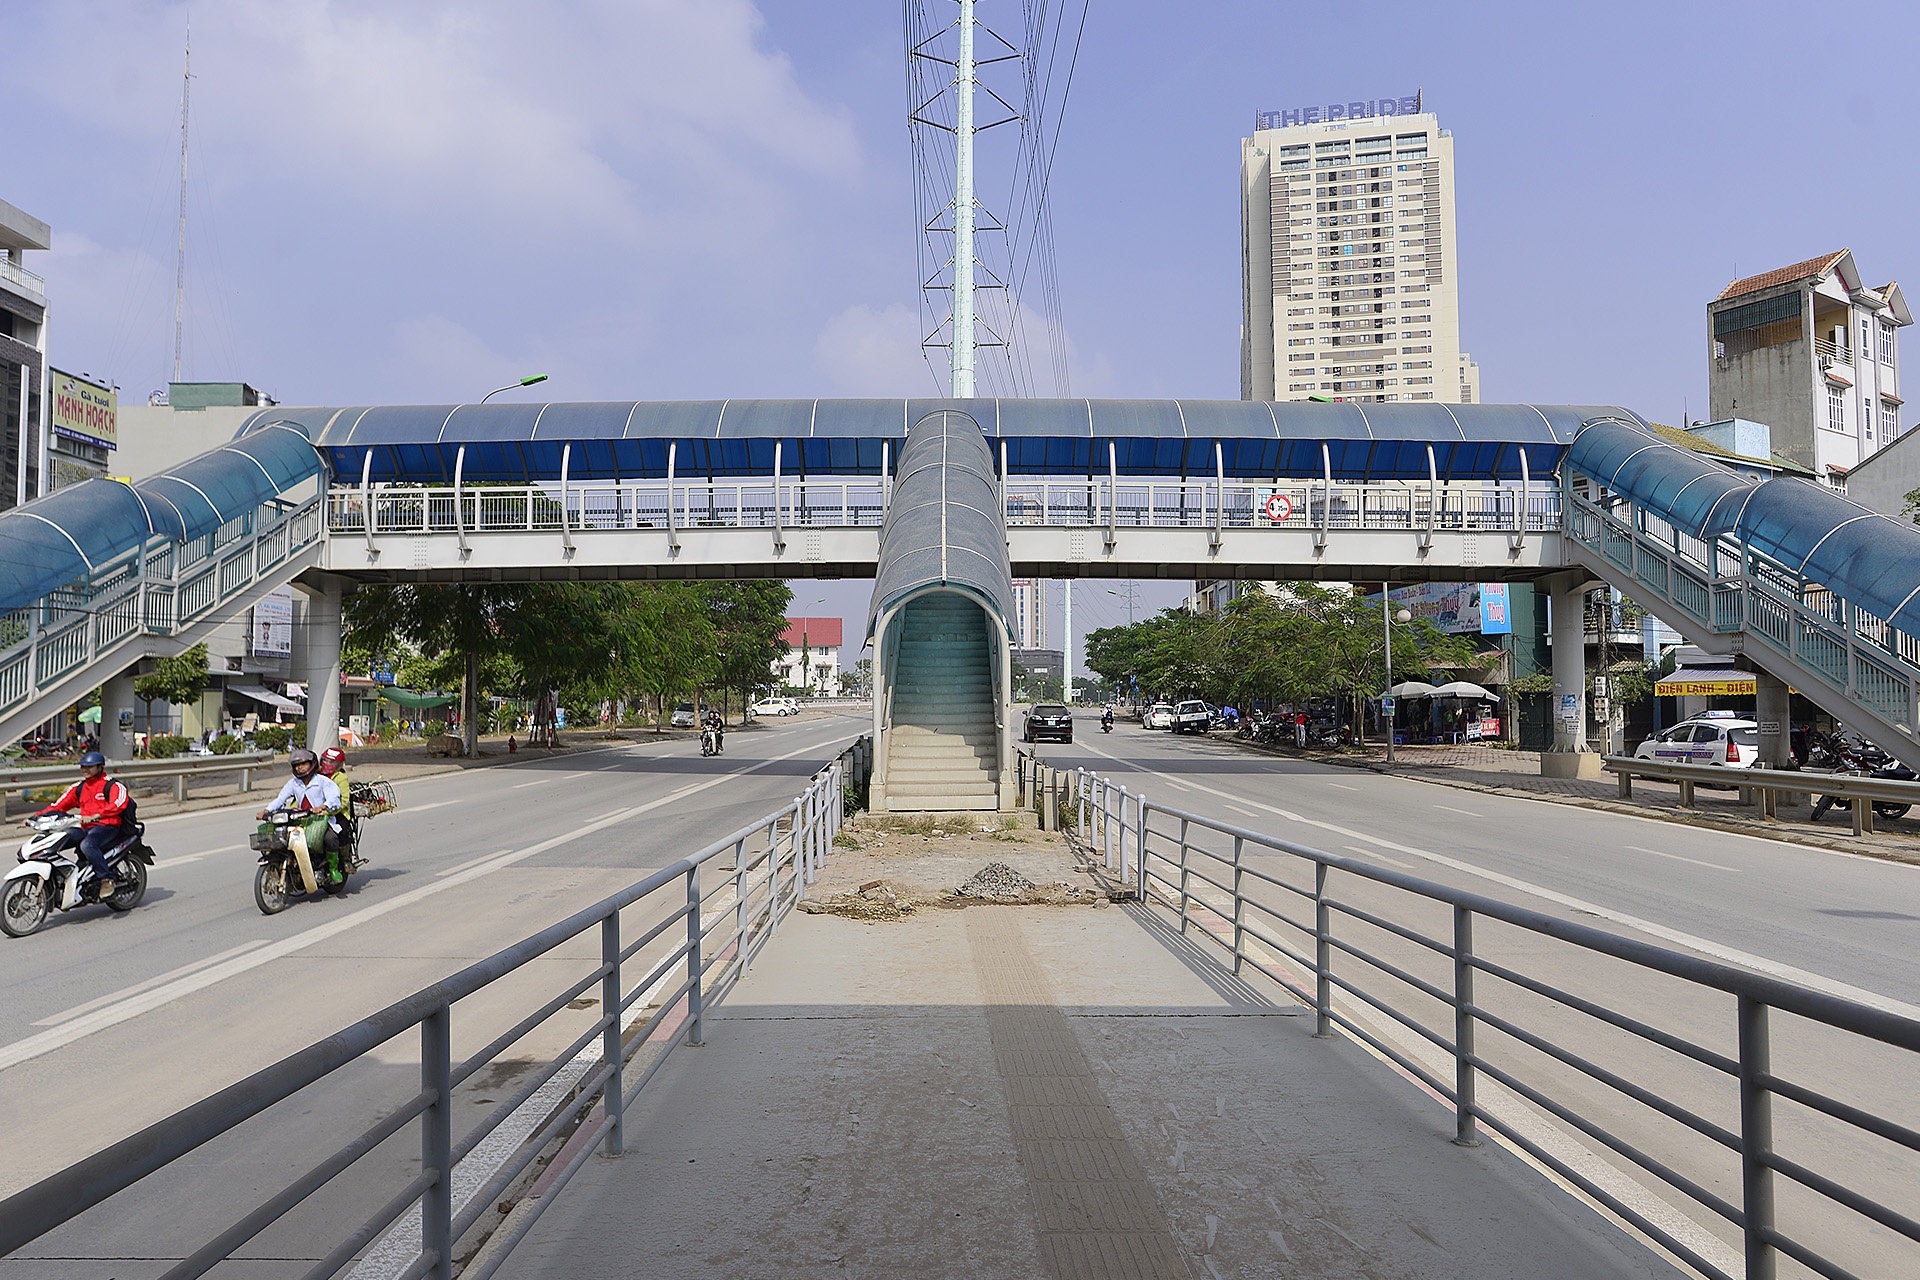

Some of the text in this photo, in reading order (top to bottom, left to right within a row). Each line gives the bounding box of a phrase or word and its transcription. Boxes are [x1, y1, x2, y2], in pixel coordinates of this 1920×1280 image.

[1262, 95, 1418, 129] THE PRIDE
[80, 390, 92, 401] Gà
[57, 393, 115, 435] MẠNH HOẠCH
[1658, 683, 1683, 695] ĐIỆN
[1686, 683, 1715, 695] LẠNH
[1727, 681, 1754, 695] ĐIỆN
